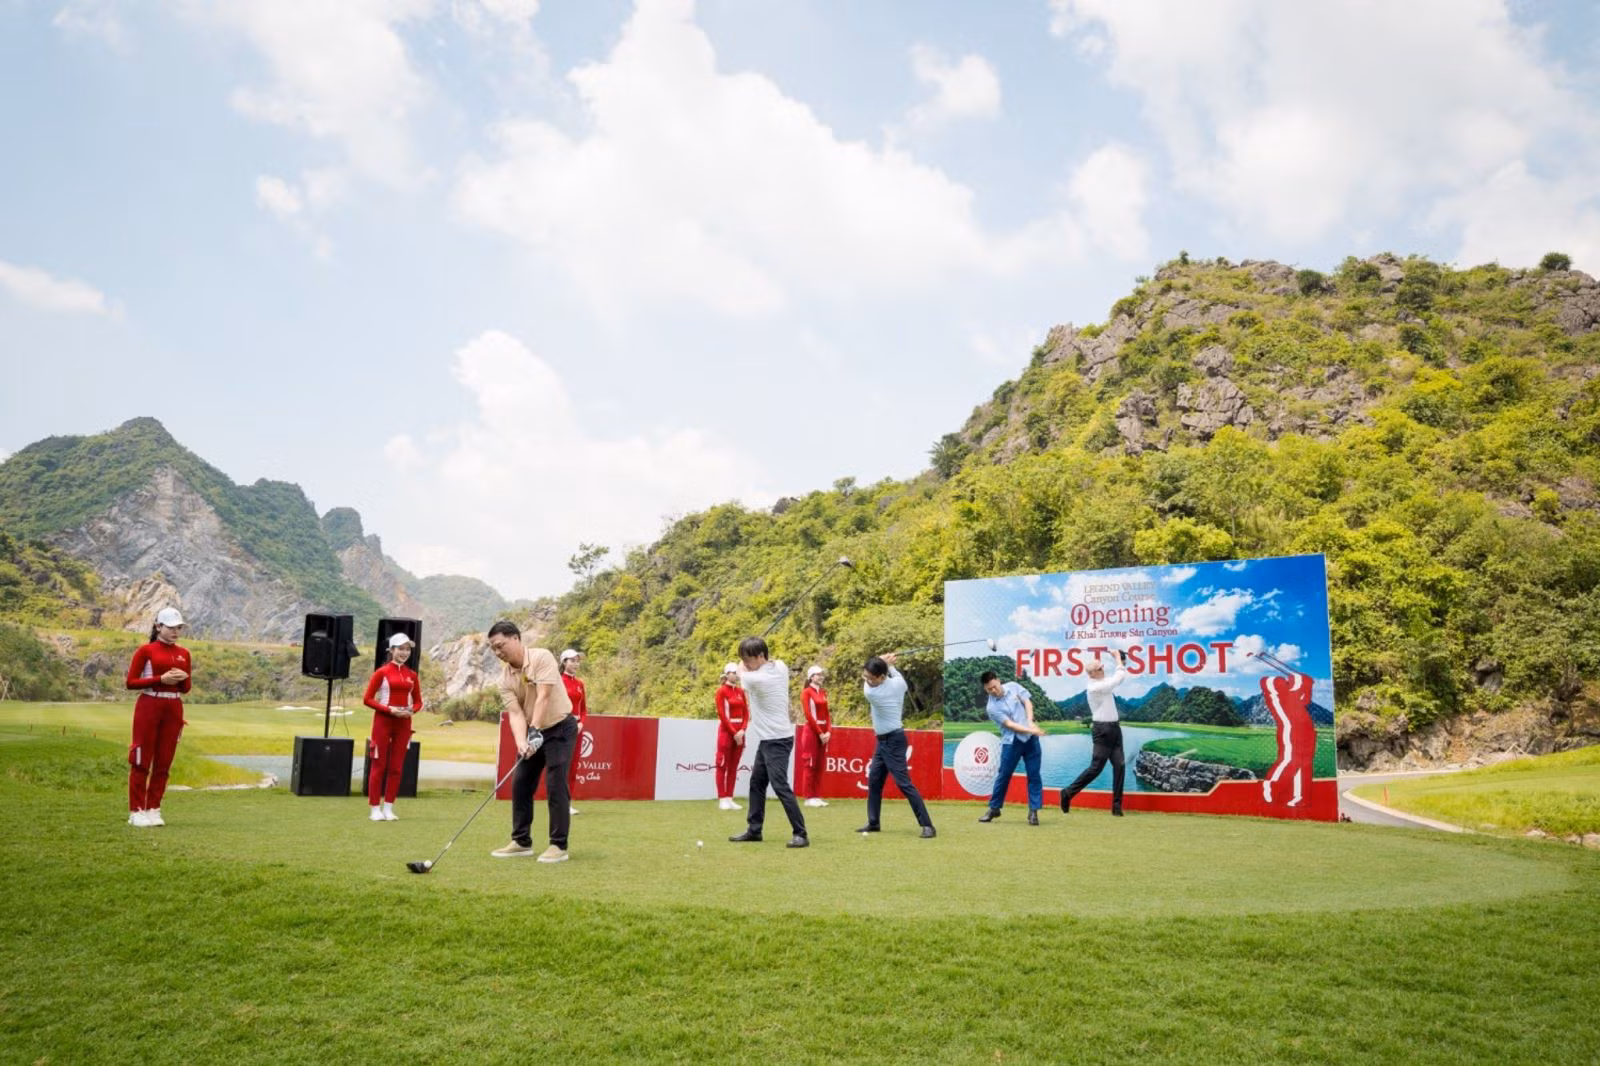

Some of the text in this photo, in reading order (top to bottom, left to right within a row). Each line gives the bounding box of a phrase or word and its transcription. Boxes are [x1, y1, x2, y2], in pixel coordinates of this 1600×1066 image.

[1084, 583, 1120, 594] LEGEND
[1084, 591, 1156, 605] Canyon Course
[1070, 603, 1171, 630] Opening
[1077, 630, 1097, 640] Khai
[1146, 626, 1178, 638] Canyon
[1015, 642, 1234, 677] FIRST SHOT
[583, 761, 612, 770] VALLEY
[826, 757, 864, 774] BRG
